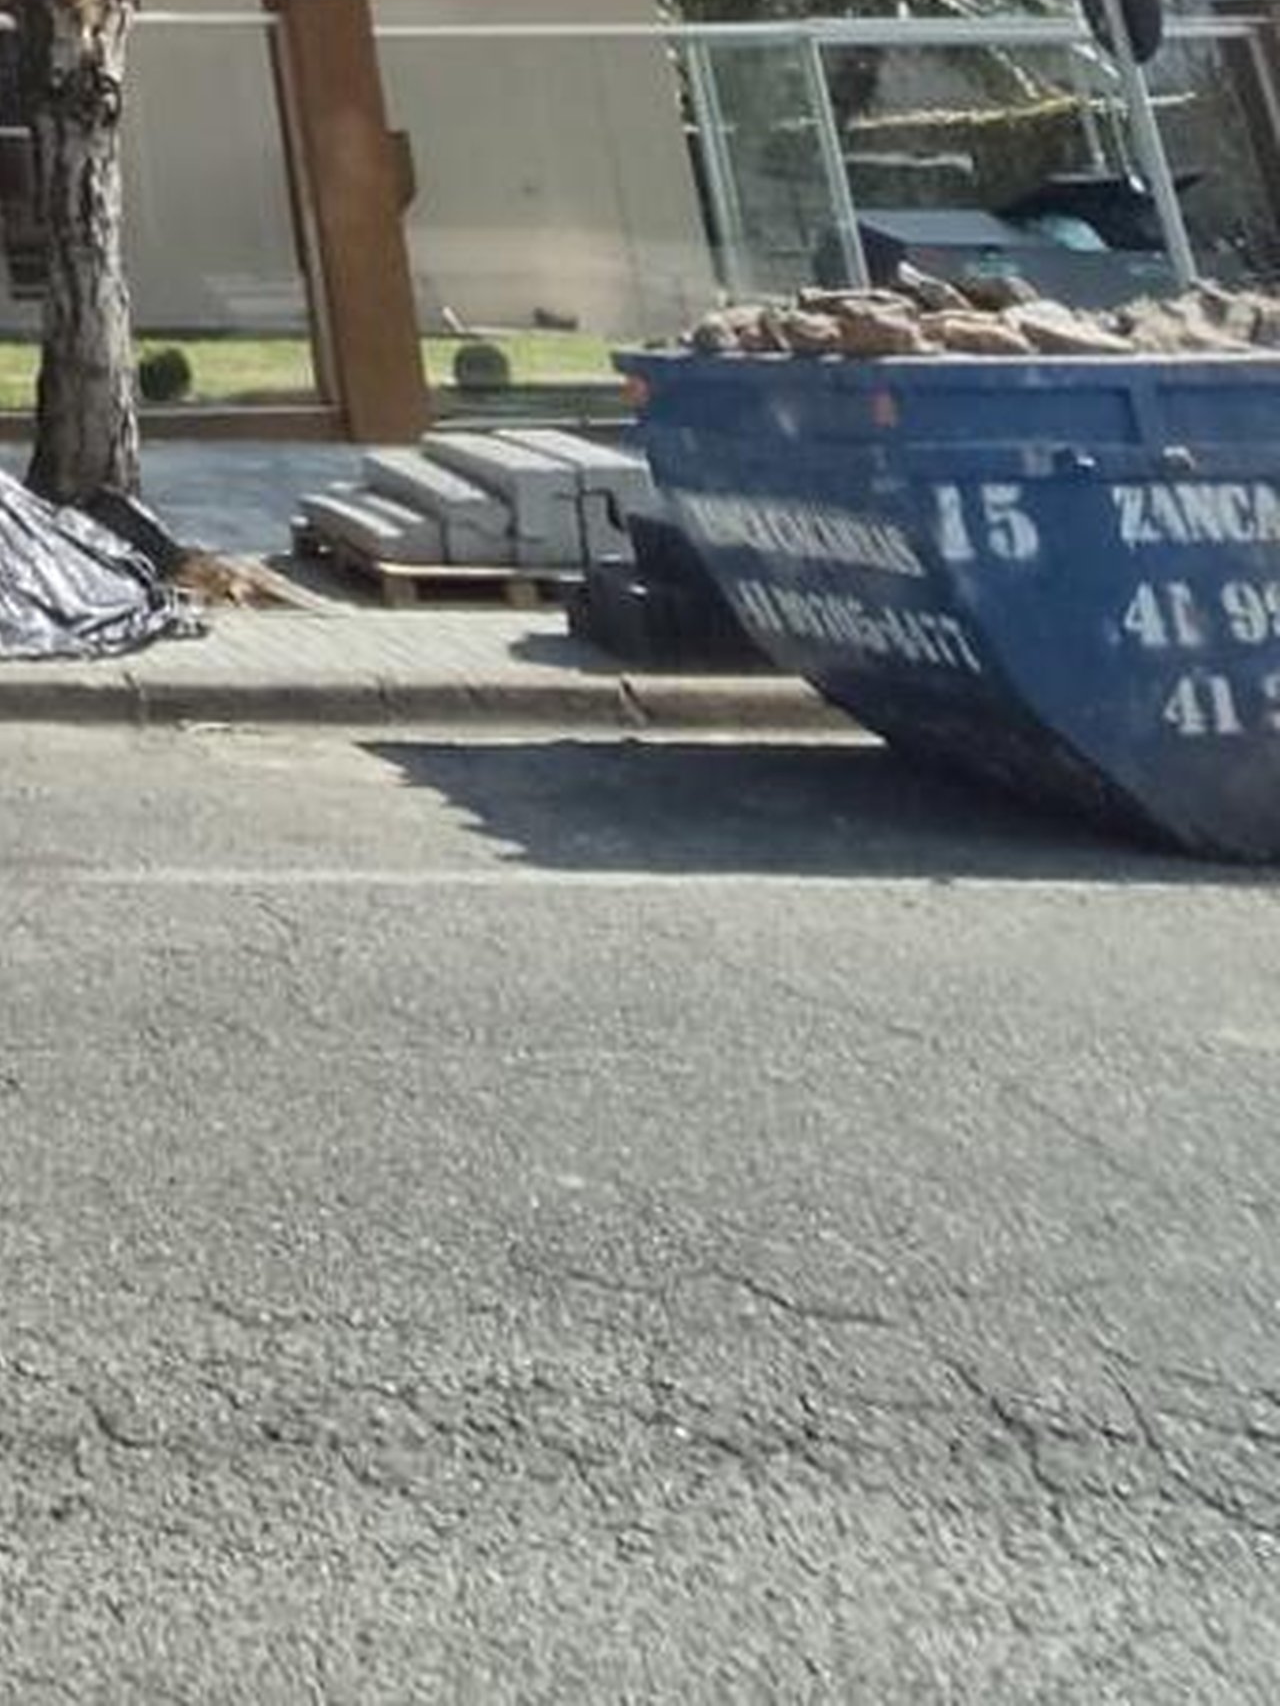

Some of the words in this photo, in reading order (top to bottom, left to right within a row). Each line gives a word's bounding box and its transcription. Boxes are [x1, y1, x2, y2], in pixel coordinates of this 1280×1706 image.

[937, 483, 1039, 560] 15
[1124, 581, 1202, 647] 41
[1163, 674, 1243, 734] 41
